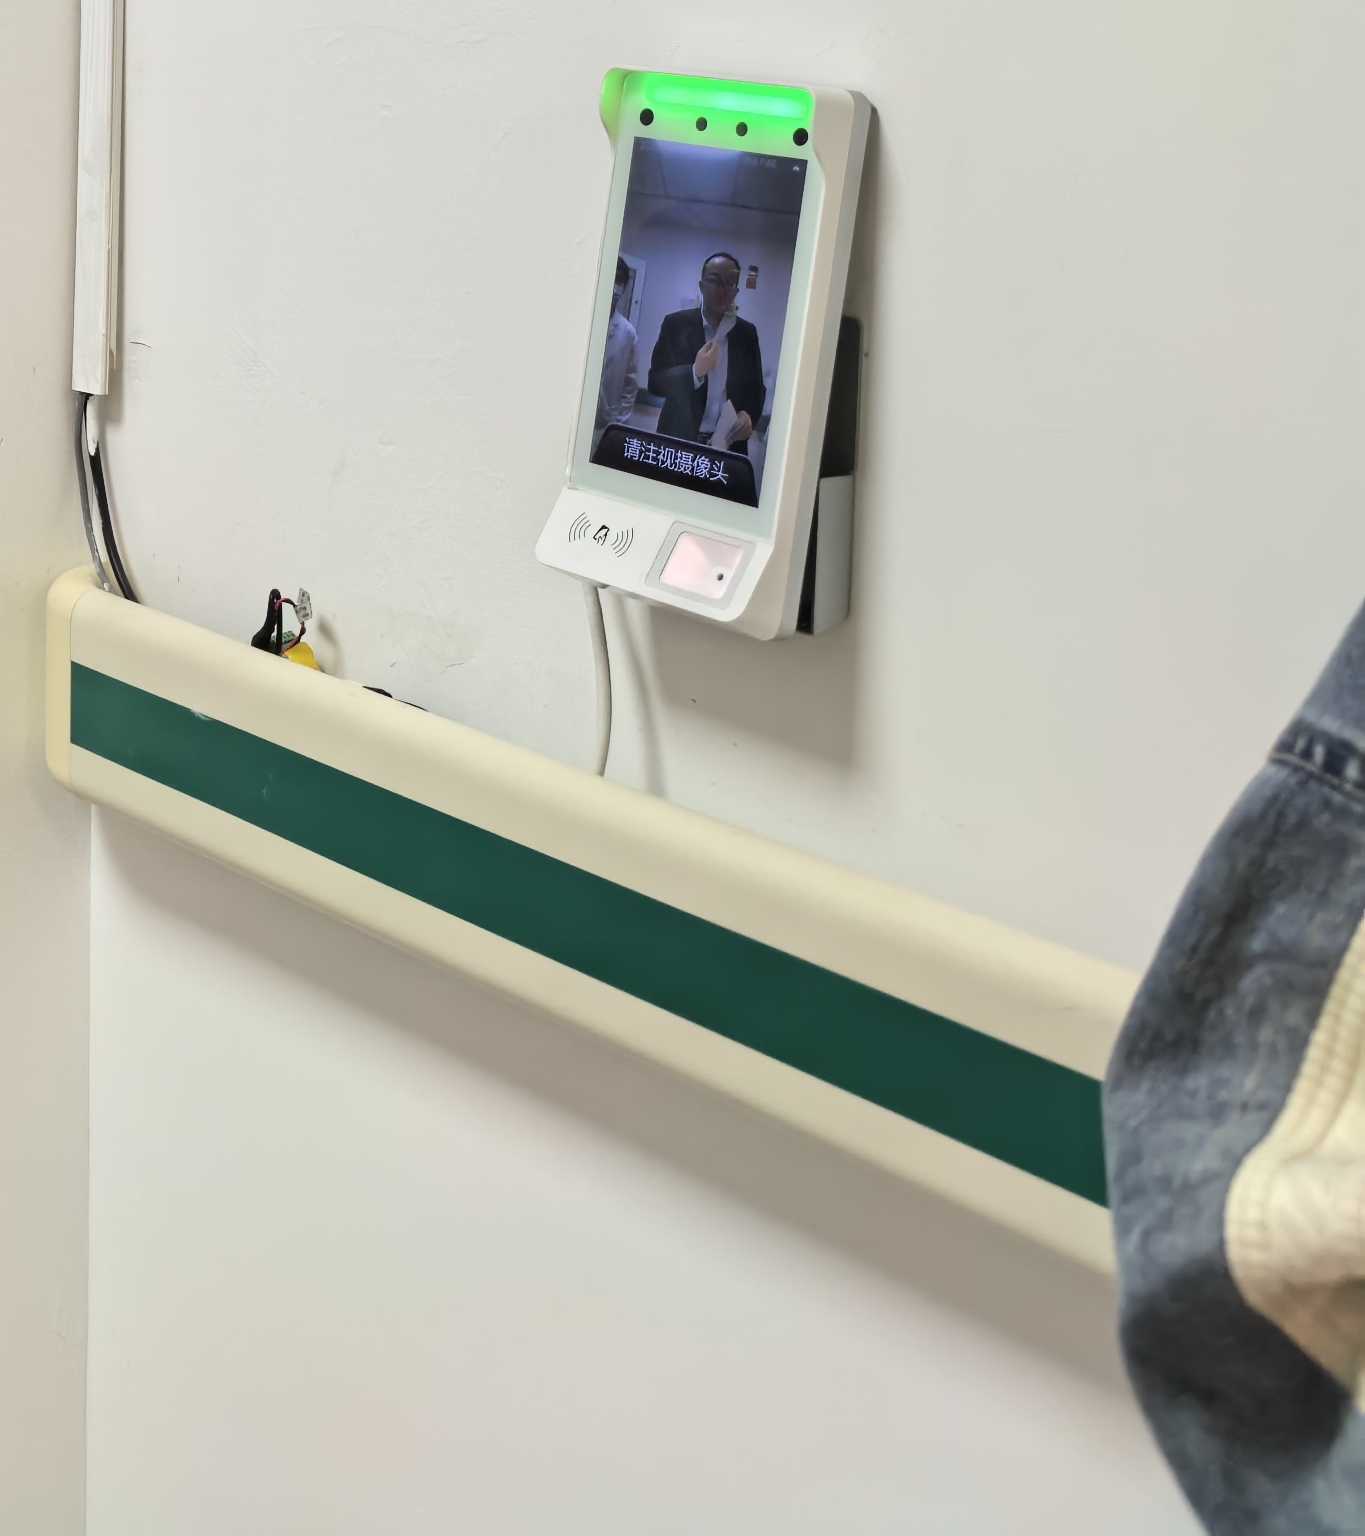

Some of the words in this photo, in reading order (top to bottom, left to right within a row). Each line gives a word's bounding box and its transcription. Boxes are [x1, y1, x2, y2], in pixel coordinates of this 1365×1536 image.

[623, 437, 729, 484] 请注视摄像头
